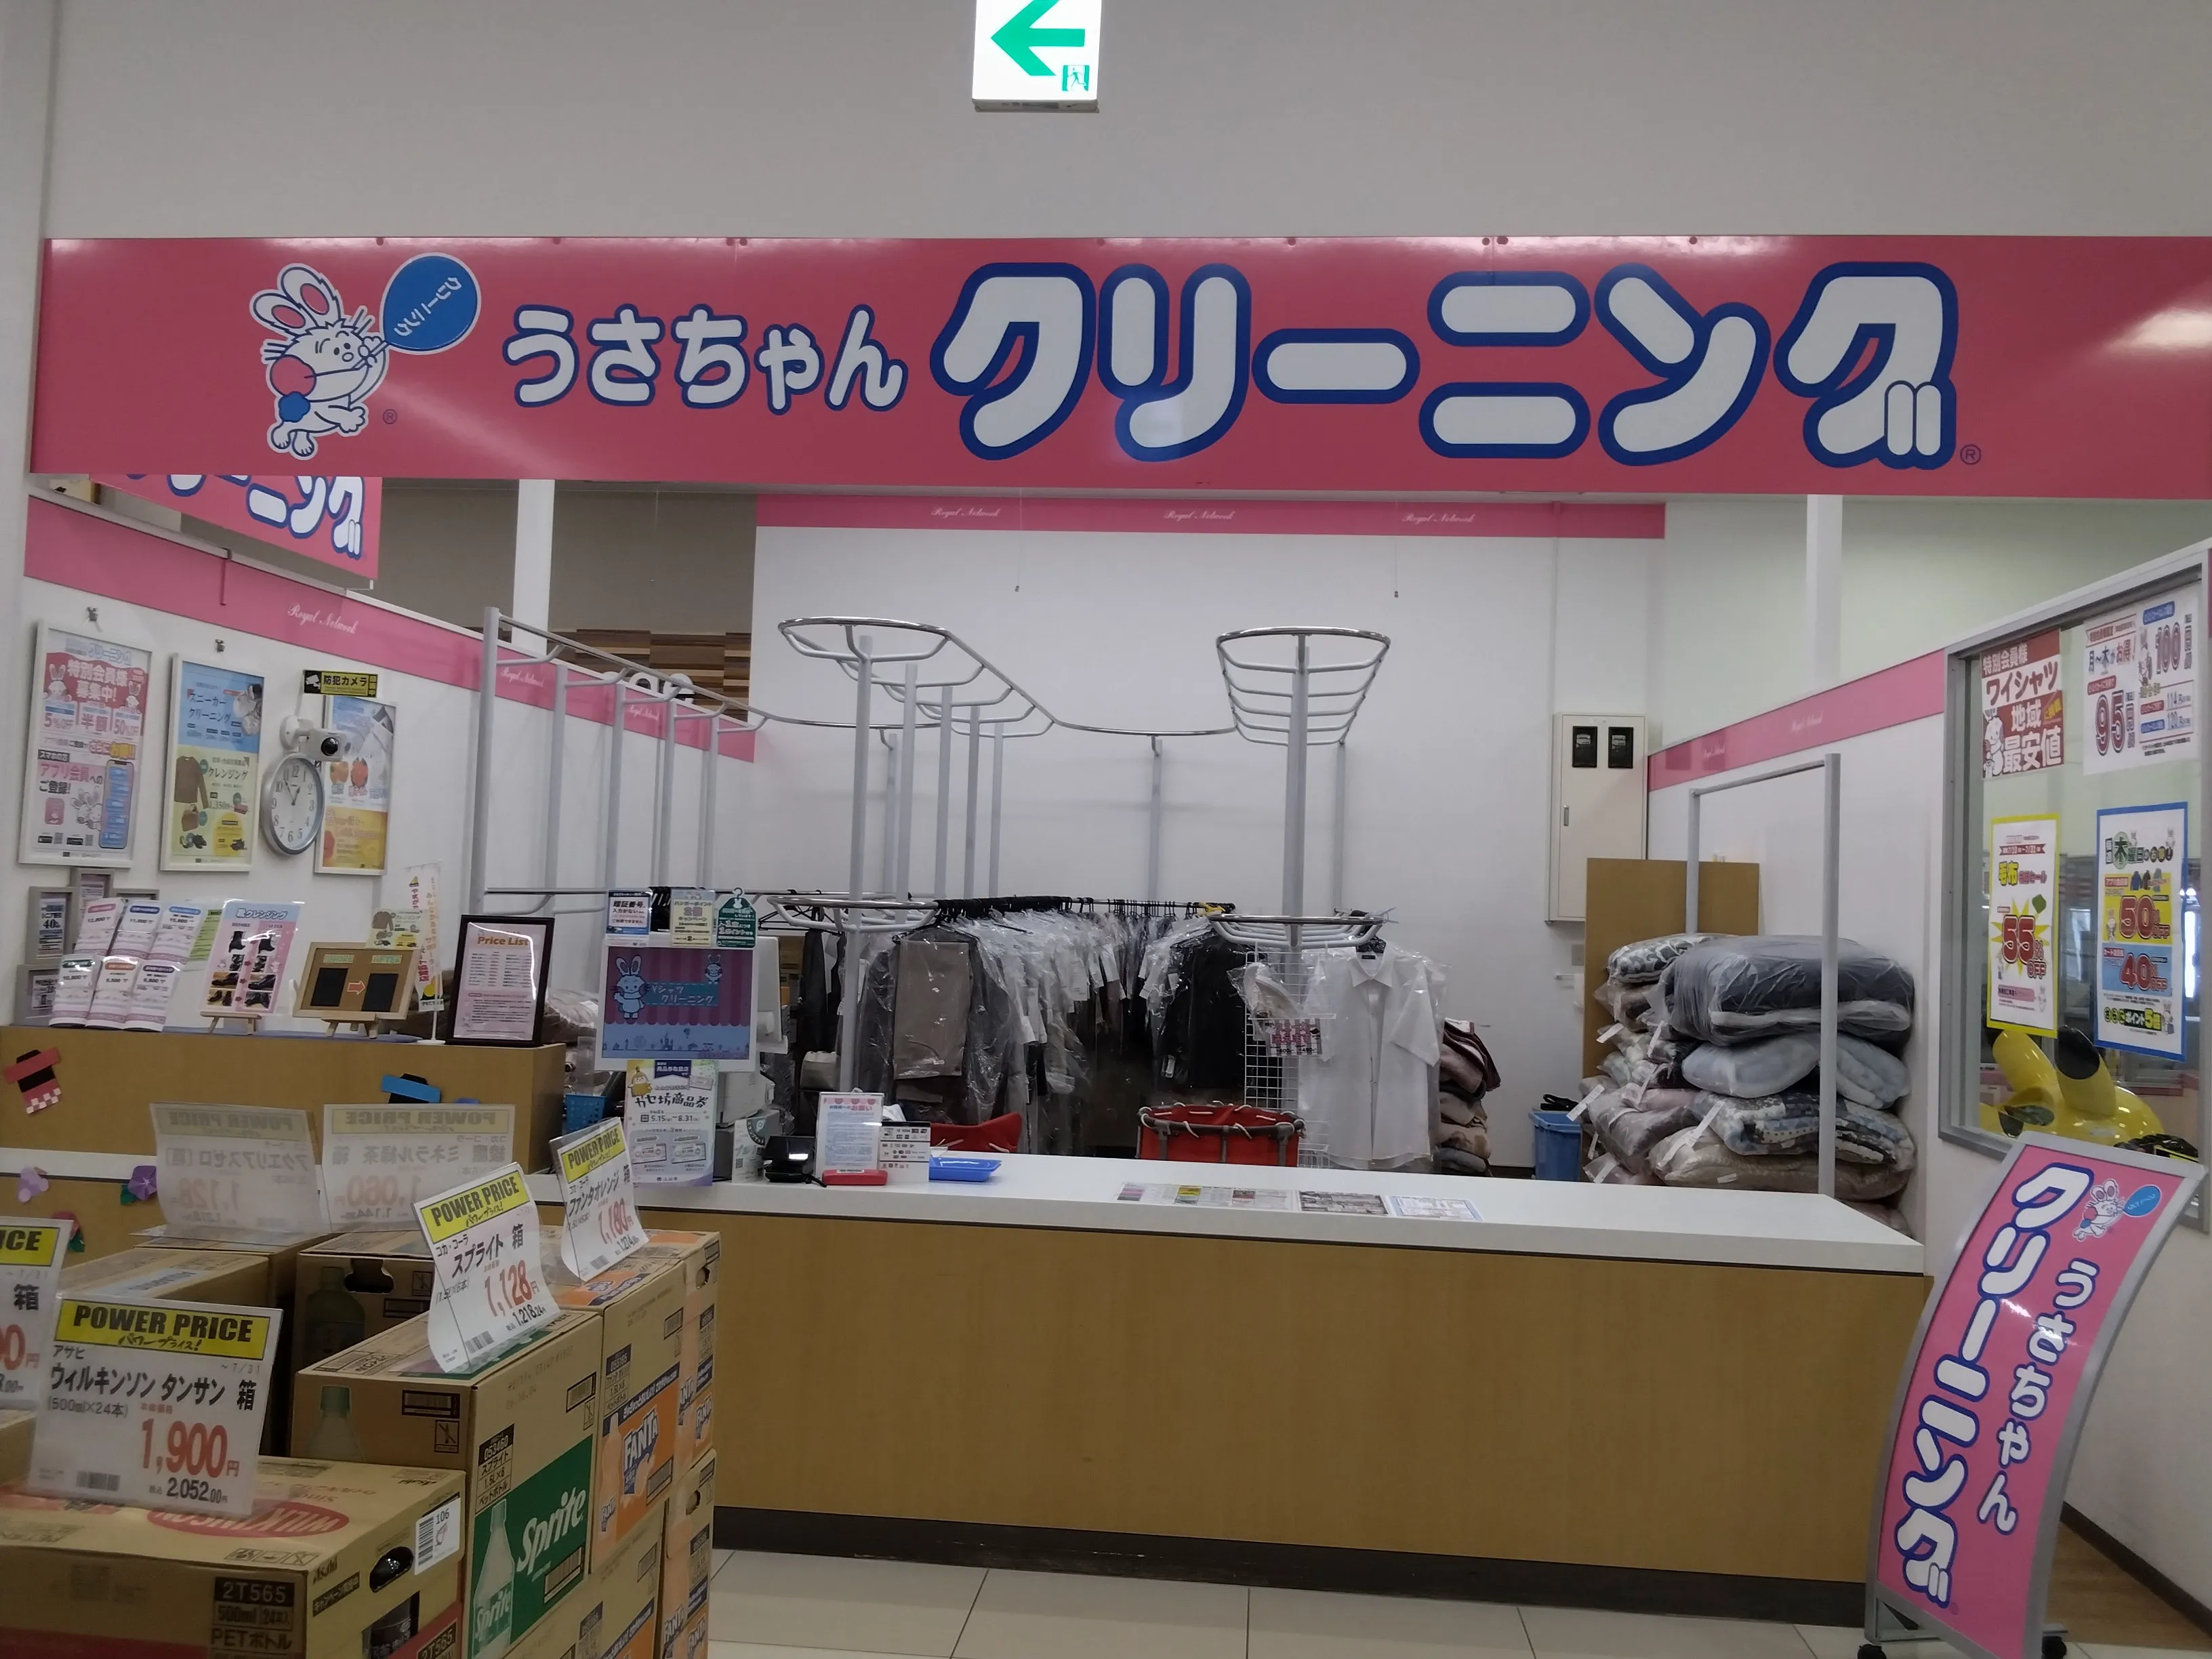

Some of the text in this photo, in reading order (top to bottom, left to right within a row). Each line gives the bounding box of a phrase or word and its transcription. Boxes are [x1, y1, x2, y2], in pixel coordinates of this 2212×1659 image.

[503, 261, 1959, 469] うさちゃん クリーニング
[287, 602, 319, 624] Royal
[1983, 642, 2028, 675] 特別会員様
[323, 674, 368, 687] 防犯カメラ
[1986, 661, 2059, 706] ワイシャツ
[188, 708, 232, 723] クリーニング
[190, 693, 226, 707] スニーカー
[2011, 699, 2043, 732] 地域
[2095, 689, 2126, 756] 95
[2003, 724, 2062, 773] 最安値
[208, 766, 249, 781] クレンジング
[477, 936, 529, 946] Price List
[661, 994, 714, 1004] クリーニング
[567, 1128, 620, 1169] POWER PRICE
[430, 1176, 520, 1227] POWER PRICE
[569, 1170, 619, 1217] ファンタオレンジ
[451, 1223, 524, 1279] スプライト 箱
[14, 1284, 40, 1311] 箱
[73, 1304, 253, 1343] POWER PRICE
[53, 1345, 85, 1360] アサヒ
[50, 1362, 257, 1411] ウィルキンソン タンサン 箱
[1894, 1161, 2095, 1609] クリーニング
[1976, 1258, 2100, 1535] うさちゃん
[623, 1408, 659, 1471] FANTA
[481, 1450, 510, 1475] スプライト
[478, 1481, 509, 1508] ペットボトル
[436, 1507, 450, 1524] 106
[516, 1486, 587, 1576] Sprite
[222, 1581, 287, 1603] 2T565
[476, 1588, 512, 1641] Sprite
[210, 1628, 292, 1650] PETボトル
